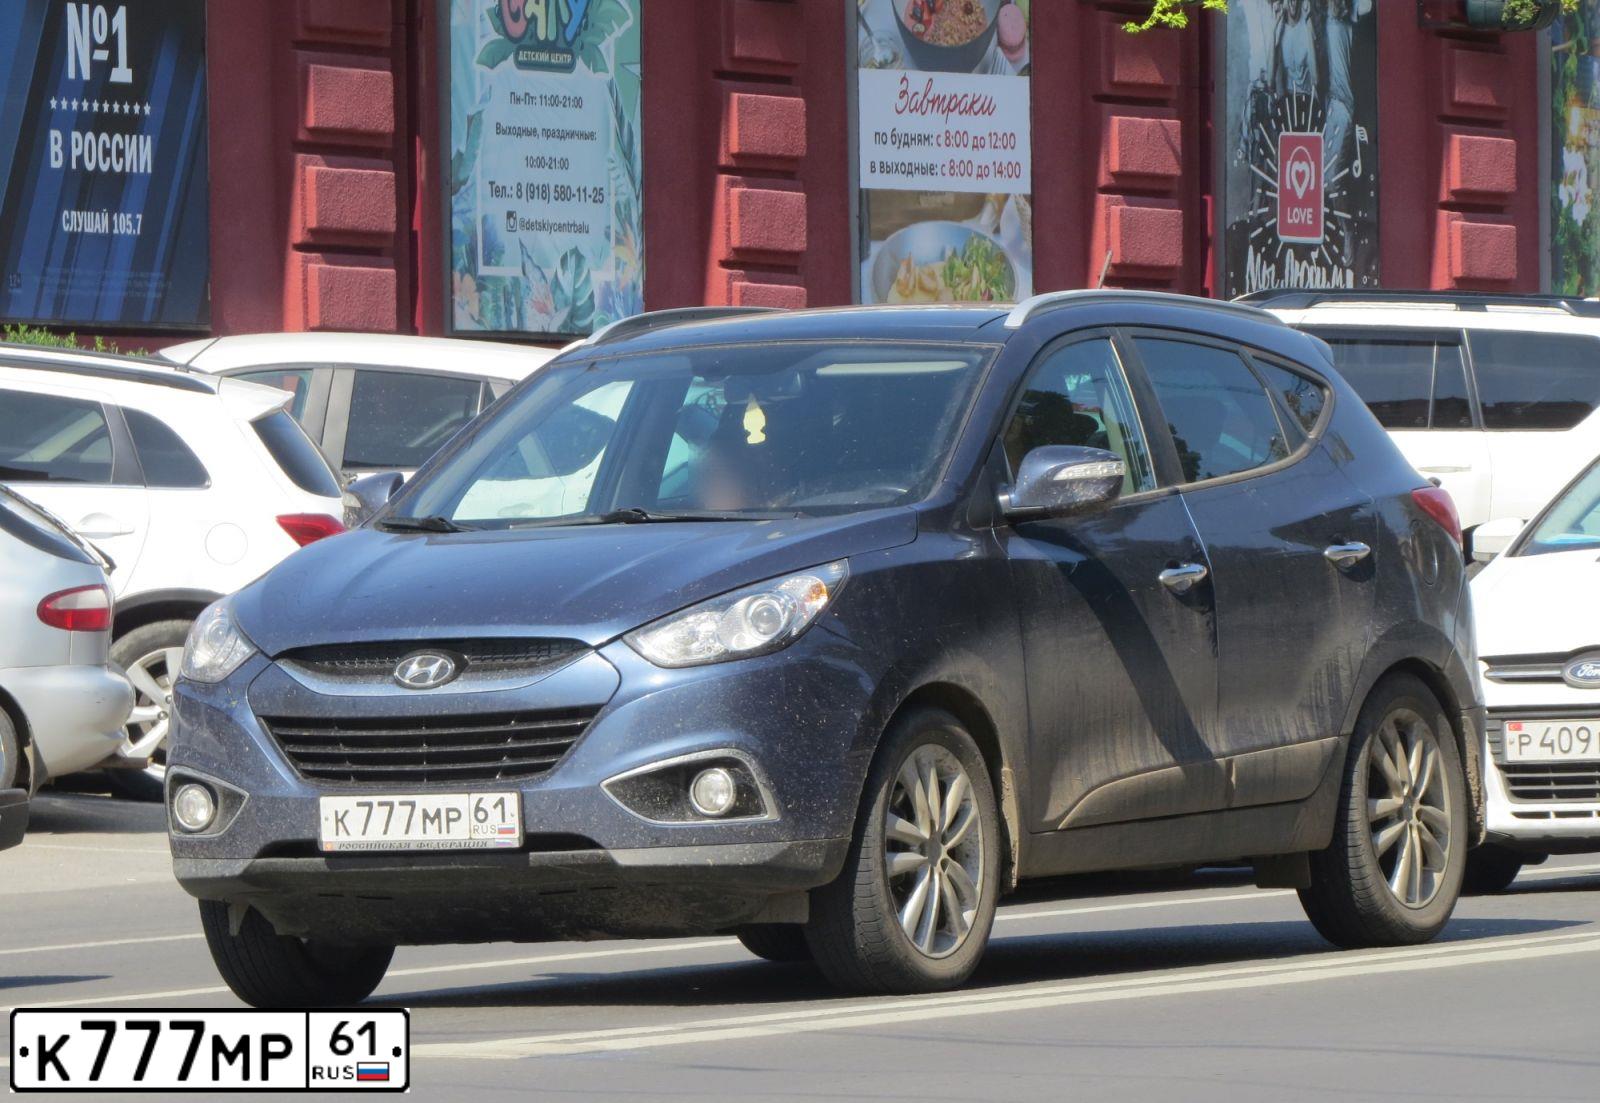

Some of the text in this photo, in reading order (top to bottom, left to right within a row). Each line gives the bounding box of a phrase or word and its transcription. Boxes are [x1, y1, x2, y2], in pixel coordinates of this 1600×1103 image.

[518, 51, 572, 64] ДЕТСКИЙ ЦЕНТР
[509, 91, 583, 109] Пн-Пт: 11:00-21:00
[895, 72, 997, 125] Завтраки
[495, 122, 597, 141] Выходные, праздничные:
[874, 131, 888, 145] по
[890, 128, 934, 149] будням:
[944, 129, 969, 148] 8:00
[972, 136, 986, 151] до
[988, 132, 1016, 150] 12:00
[50, 129, 152, 173] В РОССИИ
[524, 156, 569, 170] 10:00-21:00
[870, 161, 876, 173] в
[879, 160, 938, 178] выходные:
[948, 158, 973, 177] 8:00
[976, 165, 990, 180] до
[992, 161, 1021, 179] 14:00
[488, 181, 604, 204] Тел.: 8 (918) 580-11-25
[62, 209, 142, 235] СЛУШАЙ 105.7
[1287, 207, 1313, 225] LOVE
[1577, 664, 1600, 677] For
[334, 796, 507, 837] К777МР 61
